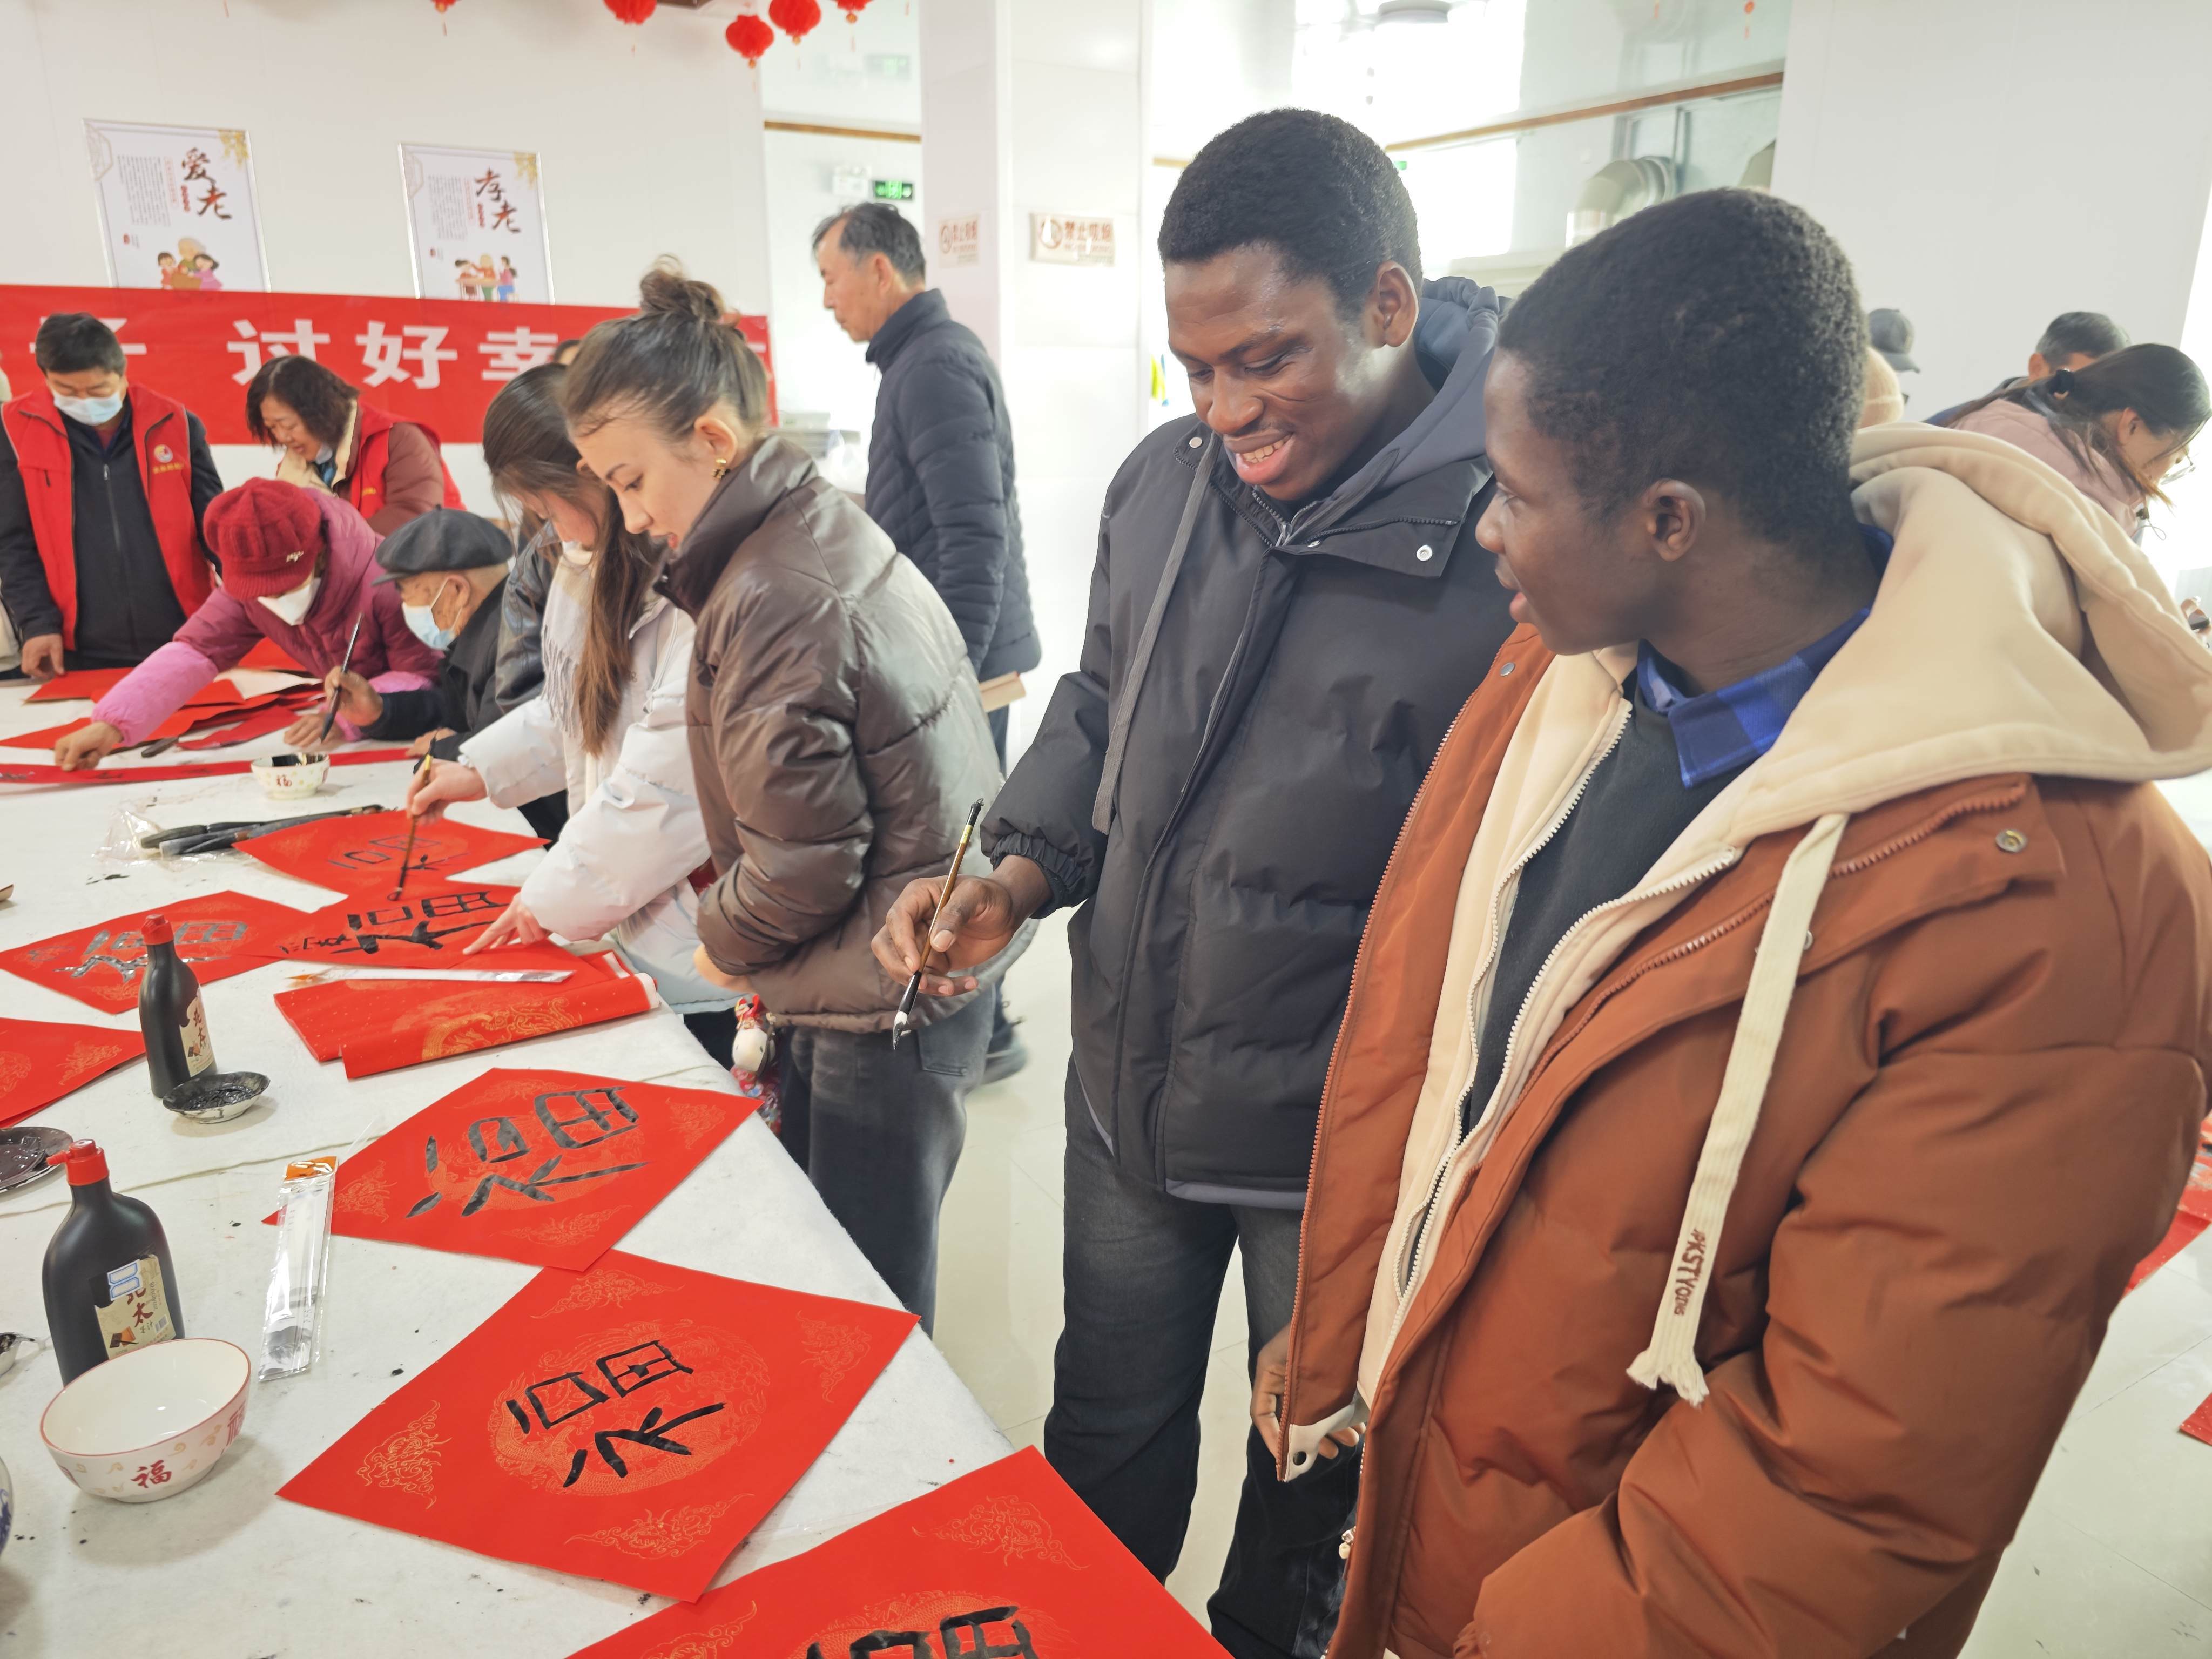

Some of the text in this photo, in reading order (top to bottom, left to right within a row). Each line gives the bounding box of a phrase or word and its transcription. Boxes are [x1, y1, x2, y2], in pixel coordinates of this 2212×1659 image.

[181, 147, 232, 220] 爱老
[475, 166, 521, 233] 孝老
[406, 1086, 648, 1218] 福
[506, 1340, 727, 1488] 福
[131, 1460, 172, 1488] 福
